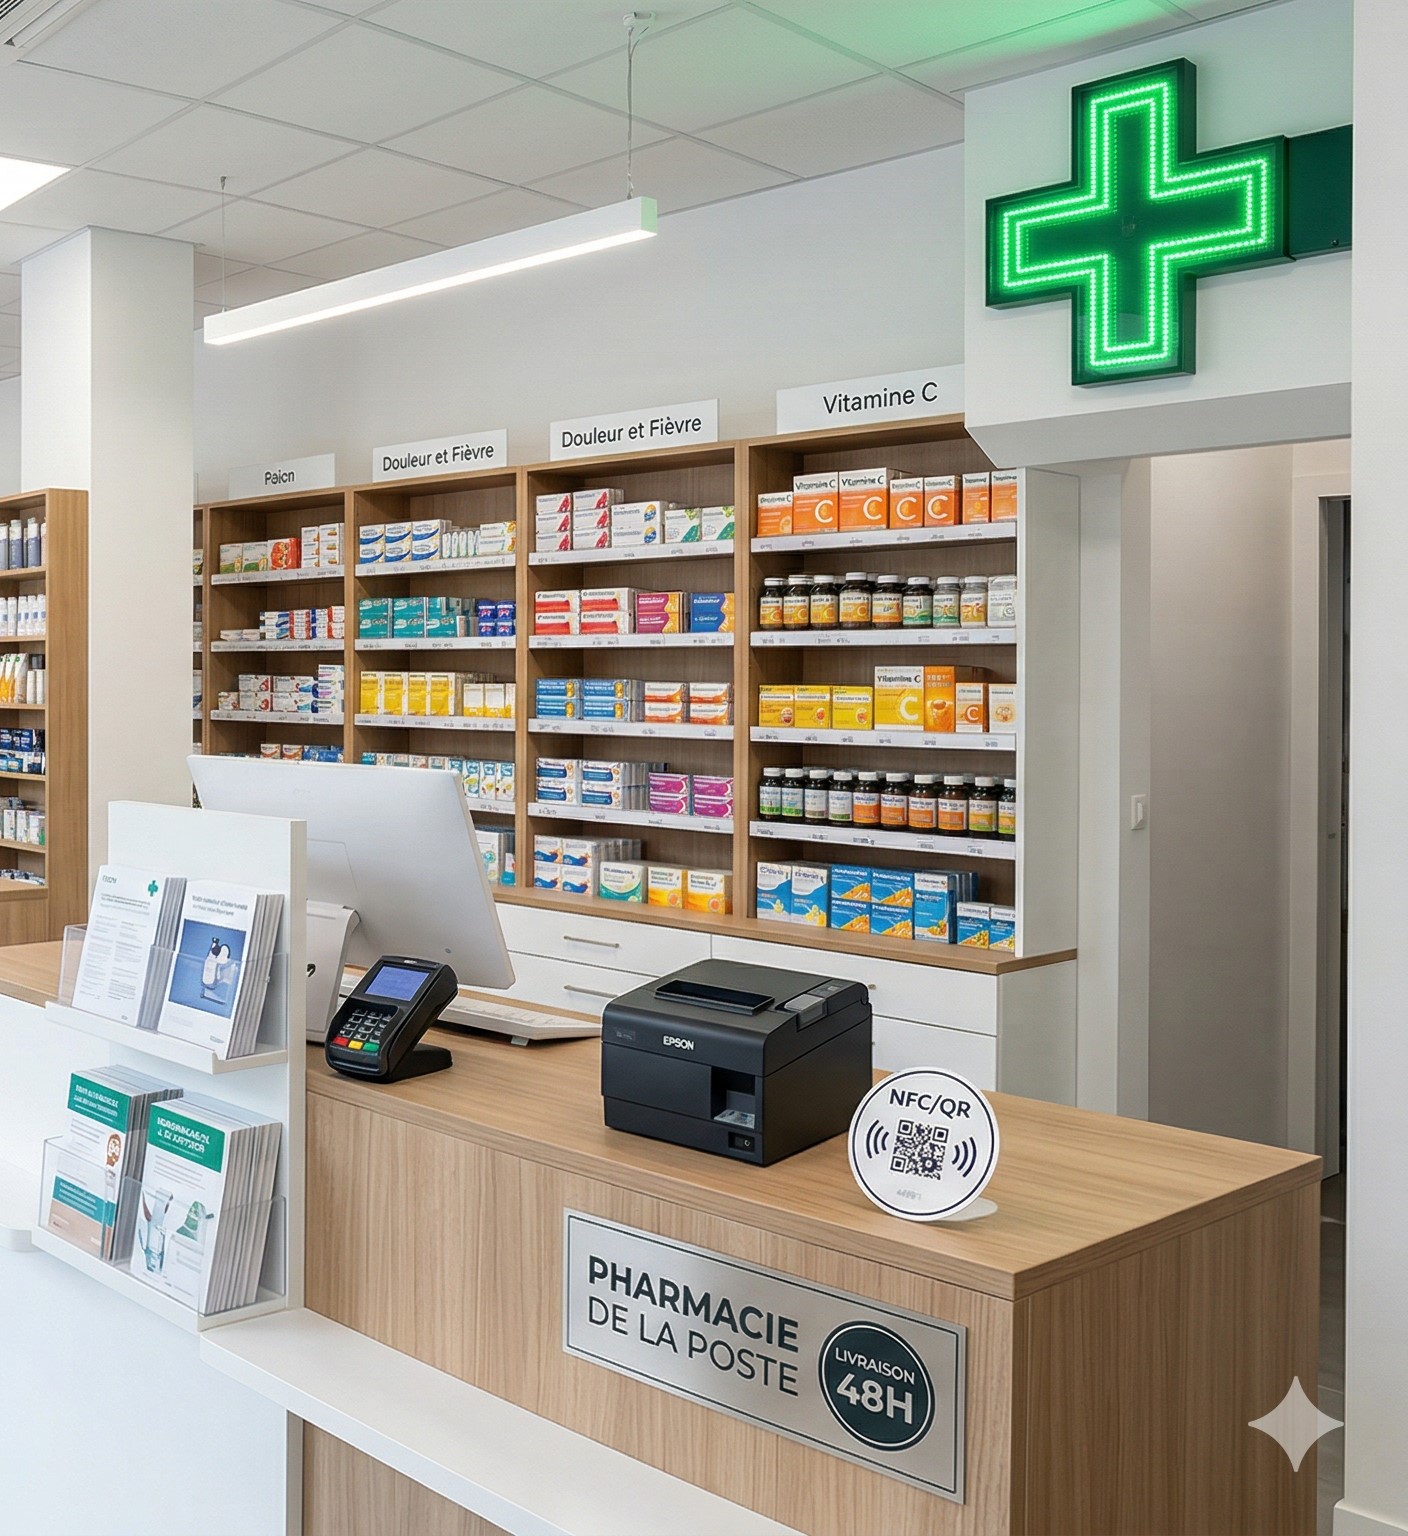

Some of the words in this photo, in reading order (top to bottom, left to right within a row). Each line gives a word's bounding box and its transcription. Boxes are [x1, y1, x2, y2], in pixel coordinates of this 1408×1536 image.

[823, 386, 915, 414] Vitamine
[921, 381, 939, 402] C
[562, 425, 624, 448] Douleur
[628, 422, 645, 440] et
[650, 415, 702, 438] Fièvre
[383, 452, 432, 472] Douleur
[435, 449, 449, 465] et
[452, 443, 494, 462] Fièvre
[814, 499, 834, 523] C
[863, 496, 883, 520] C
[896, 496, 917, 520] C
[927, 495, 949, 519] C
[899, 696, 919, 720] C
[662, 1035, 695, 1051] EPSON
[889, 1088, 971, 1119] NFC/QR
[588, 1254, 799, 1353] PHARMACIE
[588, 1295, 629, 1336] DE
[639, 1313, 679, 1354] LA
[687, 1329, 799, 1398] POSTE
[835, 1346, 916, 1386] LIVRAISON
[836, 1372, 913, 1425] 48H
